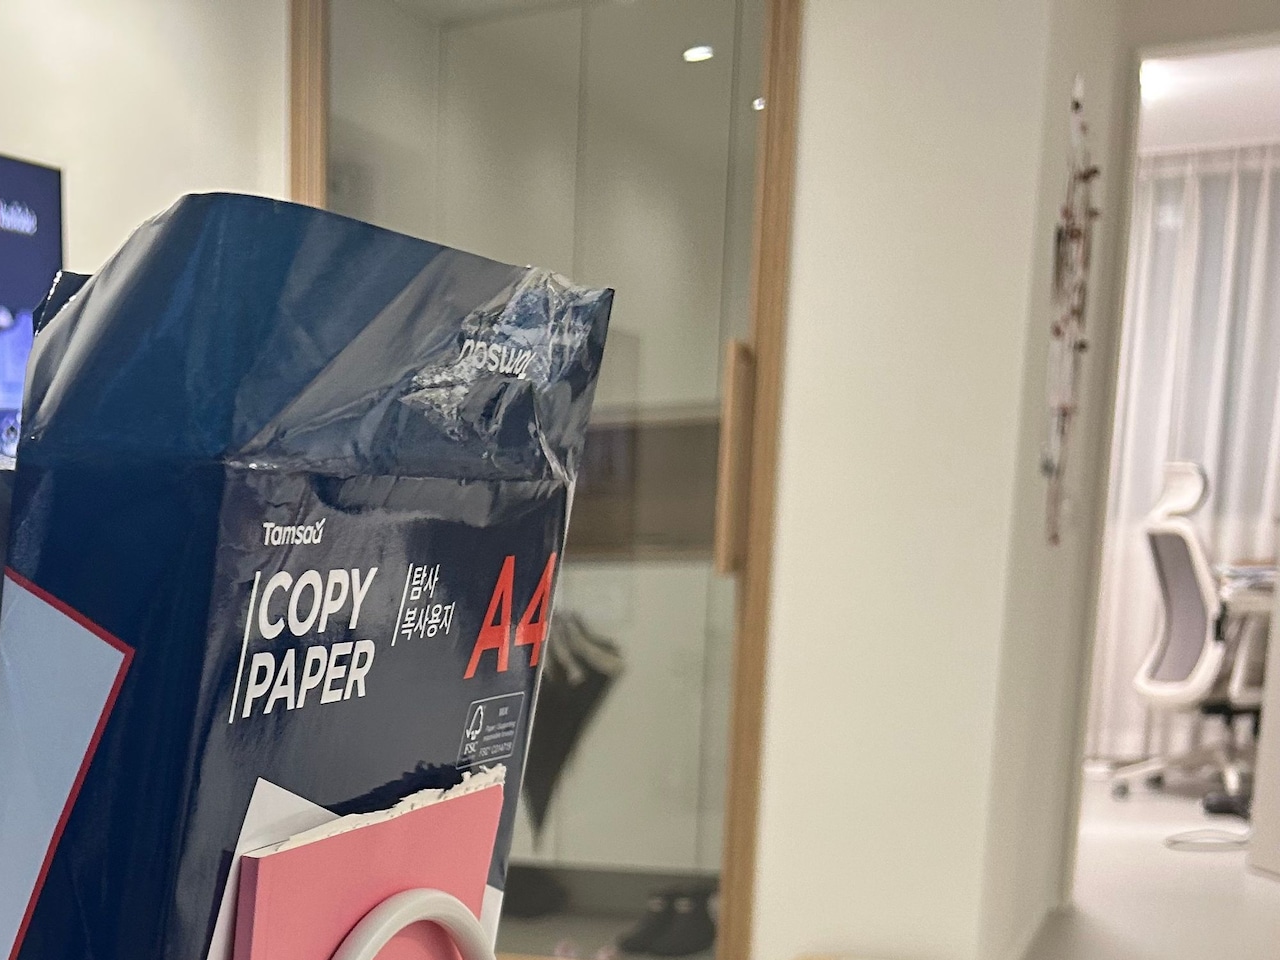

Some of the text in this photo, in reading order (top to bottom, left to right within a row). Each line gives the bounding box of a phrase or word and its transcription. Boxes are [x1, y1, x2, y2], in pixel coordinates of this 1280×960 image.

[258, 567, 378, 640] COPY
[410, 563, 440, 601] 탐사
[463, 552, 557, 680] A4
[400, 601, 456, 640] 복사용지
[241, 639, 376, 718] PAPER
